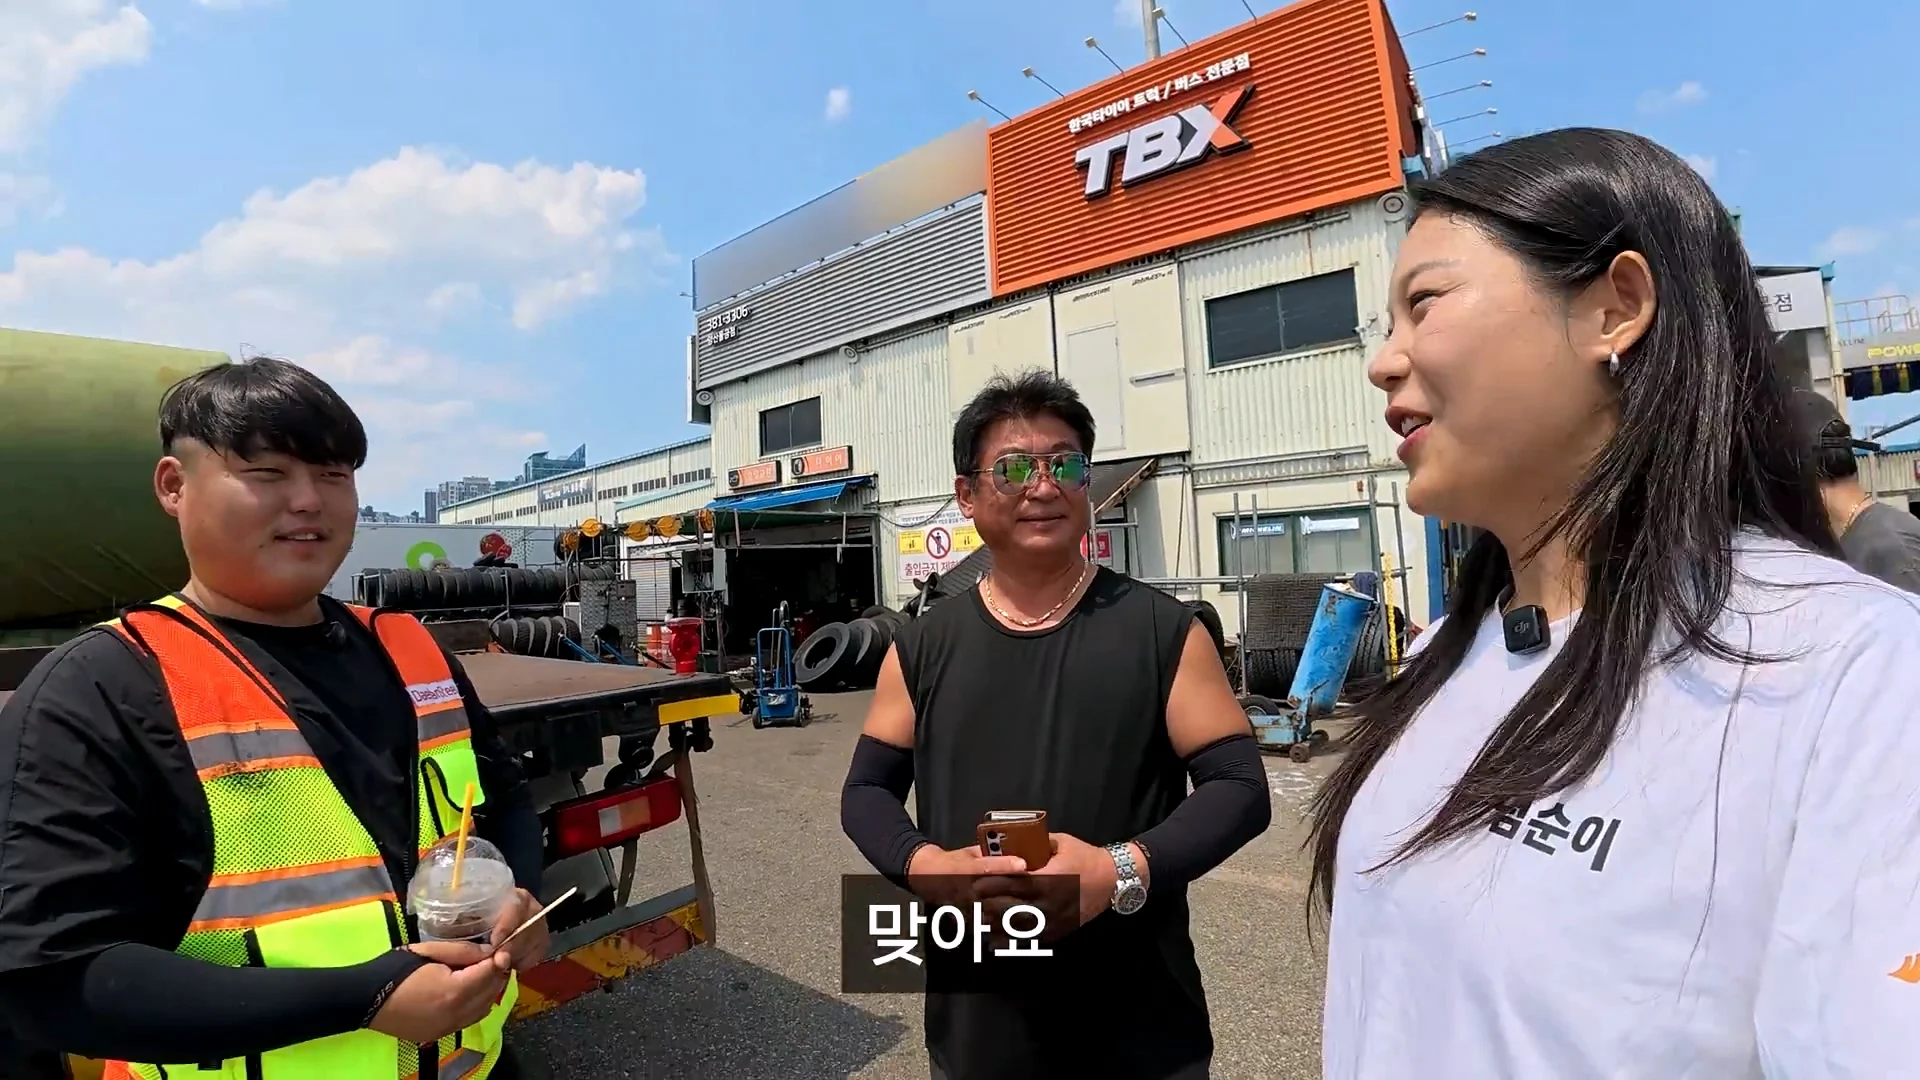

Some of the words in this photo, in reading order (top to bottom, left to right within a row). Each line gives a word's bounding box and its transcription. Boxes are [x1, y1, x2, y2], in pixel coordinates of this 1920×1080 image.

[1068, 97, 1130, 134] 한국타이어
[1133, 85, 1160, 109] 트럭
[1174, 71, 1204, 92] 버스
[1206, 51, 1251, 82] 전문점
[1075, 84, 1256, 201] TBX
